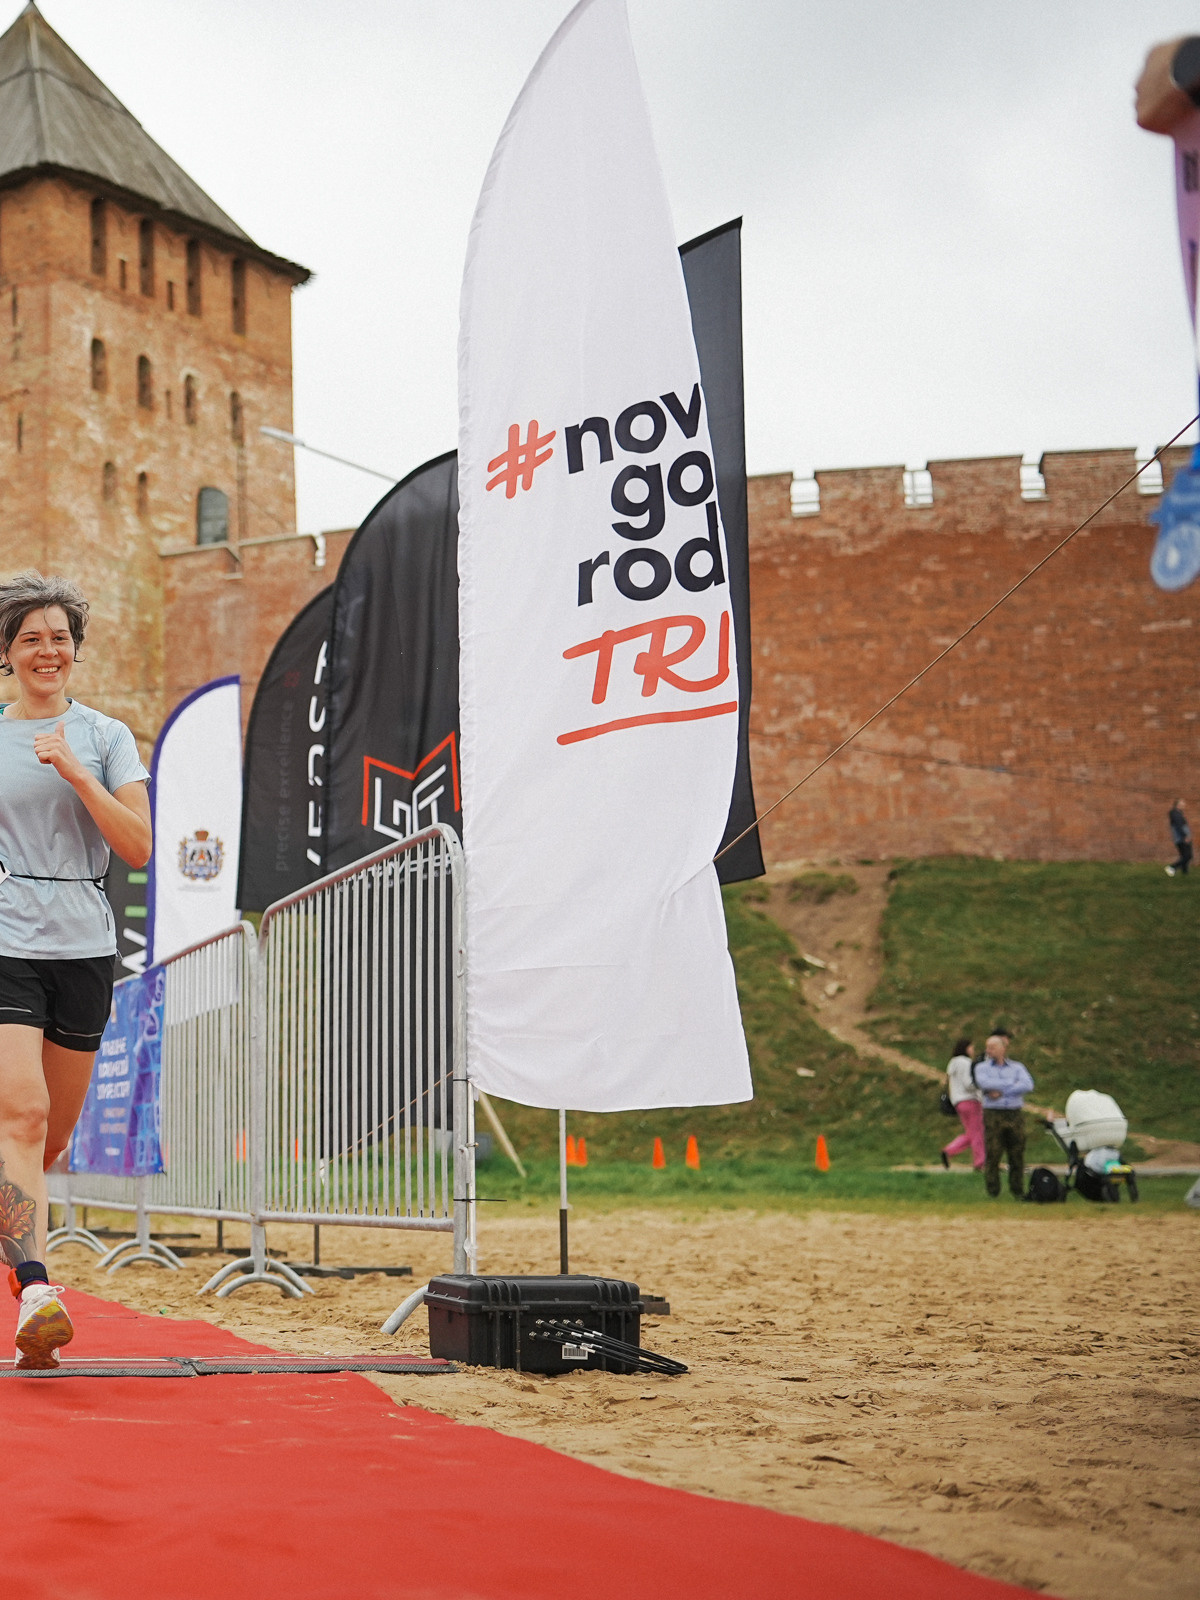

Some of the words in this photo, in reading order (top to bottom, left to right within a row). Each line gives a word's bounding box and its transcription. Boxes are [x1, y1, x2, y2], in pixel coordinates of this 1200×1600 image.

[485, 381, 702, 499] #nov
[610, 450, 714, 541] go
[577, 500, 726, 607] rod
[562, 610, 731, 705] TRI
